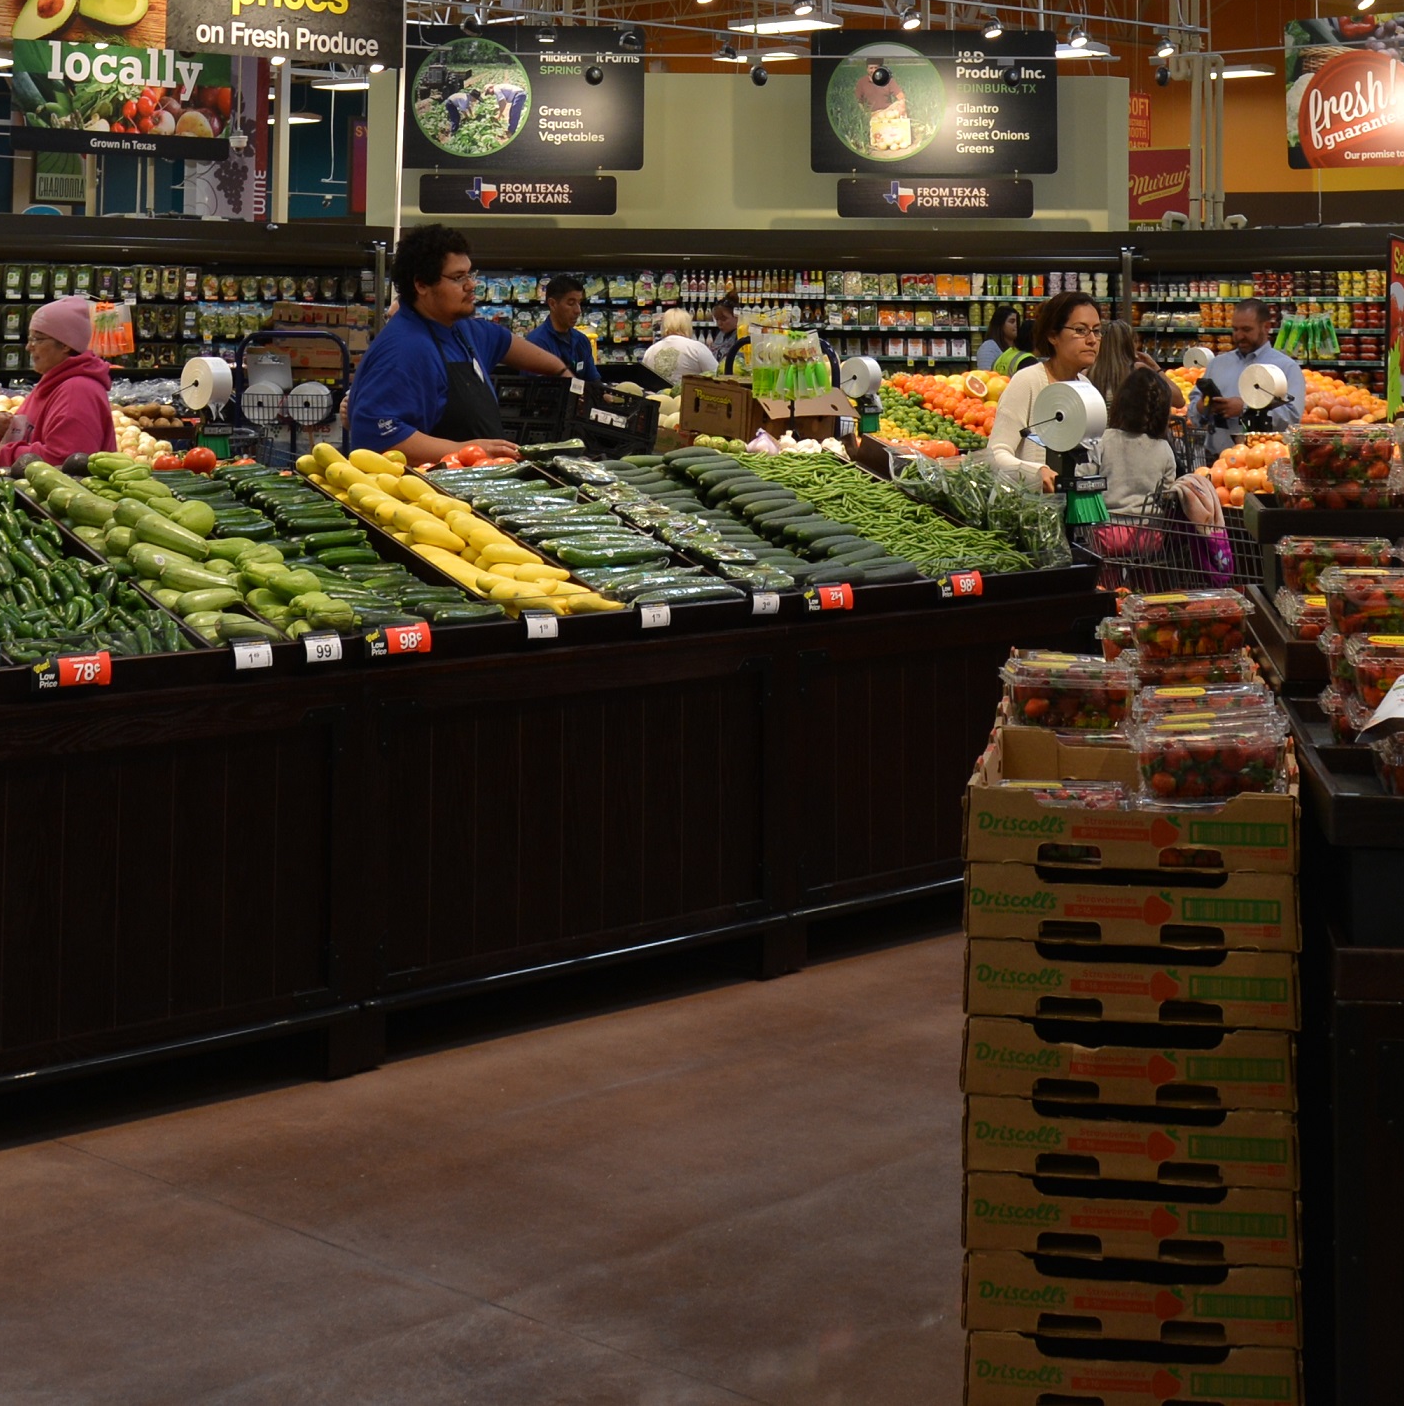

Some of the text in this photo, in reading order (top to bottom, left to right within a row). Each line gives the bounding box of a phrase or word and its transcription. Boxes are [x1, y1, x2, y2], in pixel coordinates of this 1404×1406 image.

[196, 21, 379, 57] on Fresh Produce
[955, 51, 984, 63] J&D
[47, 40, 203, 101] locally
[539, 65, 582, 75] SPRING
[1021, 67, 1046, 79] Inc.
[1022, 84, 1036, 93] TX
[539, 105, 582, 116] Greens
[956, 103, 999, 113] Cilantro
[1309, 59, 1397, 150] fresh!
[539, 118, 584, 131] Squash
[956, 116, 995, 129] Parsley
[538, 131, 605, 145] Vegetables
[956, 130, 1030, 140] Sweet Onions
[90, 137, 157, 151] Grown in Texas
[956, 143, 995, 154] Greens
[1344, 151, 1360, 160] Our
[1361, 149, 1395, 161] promise
[1396, 150, 1404, 158] to
[38, 177, 86, 198] CHARDONNA
[500, 184, 573, 193] FROM TEXAS.
[917, 187, 989, 197] FROM TEXAS.
[500, 193, 572, 203] FOR TEXANS.
[917, 197, 989, 207] FOR TEXANS.
[371, 648, 387, 657] Price
[39, 672, 56, 680] Low
[39, 680, 58, 689] Price
[977, 811, 1066, 834] Driscoll's
[970, 888, 1058, 911] Driscoll's
[974, 963, 1064, 987] Driscoll's
[974, 1042, 1063, 1068] Driscoll's
[974, 1121, 1063, 1145] Driscoll's
[973, 1198, 1063, 1222] Driscoll's
[977, 1280, 1067, 1305] Driscoll's
[975, 1359, 1065, 1384] Driscoll's
